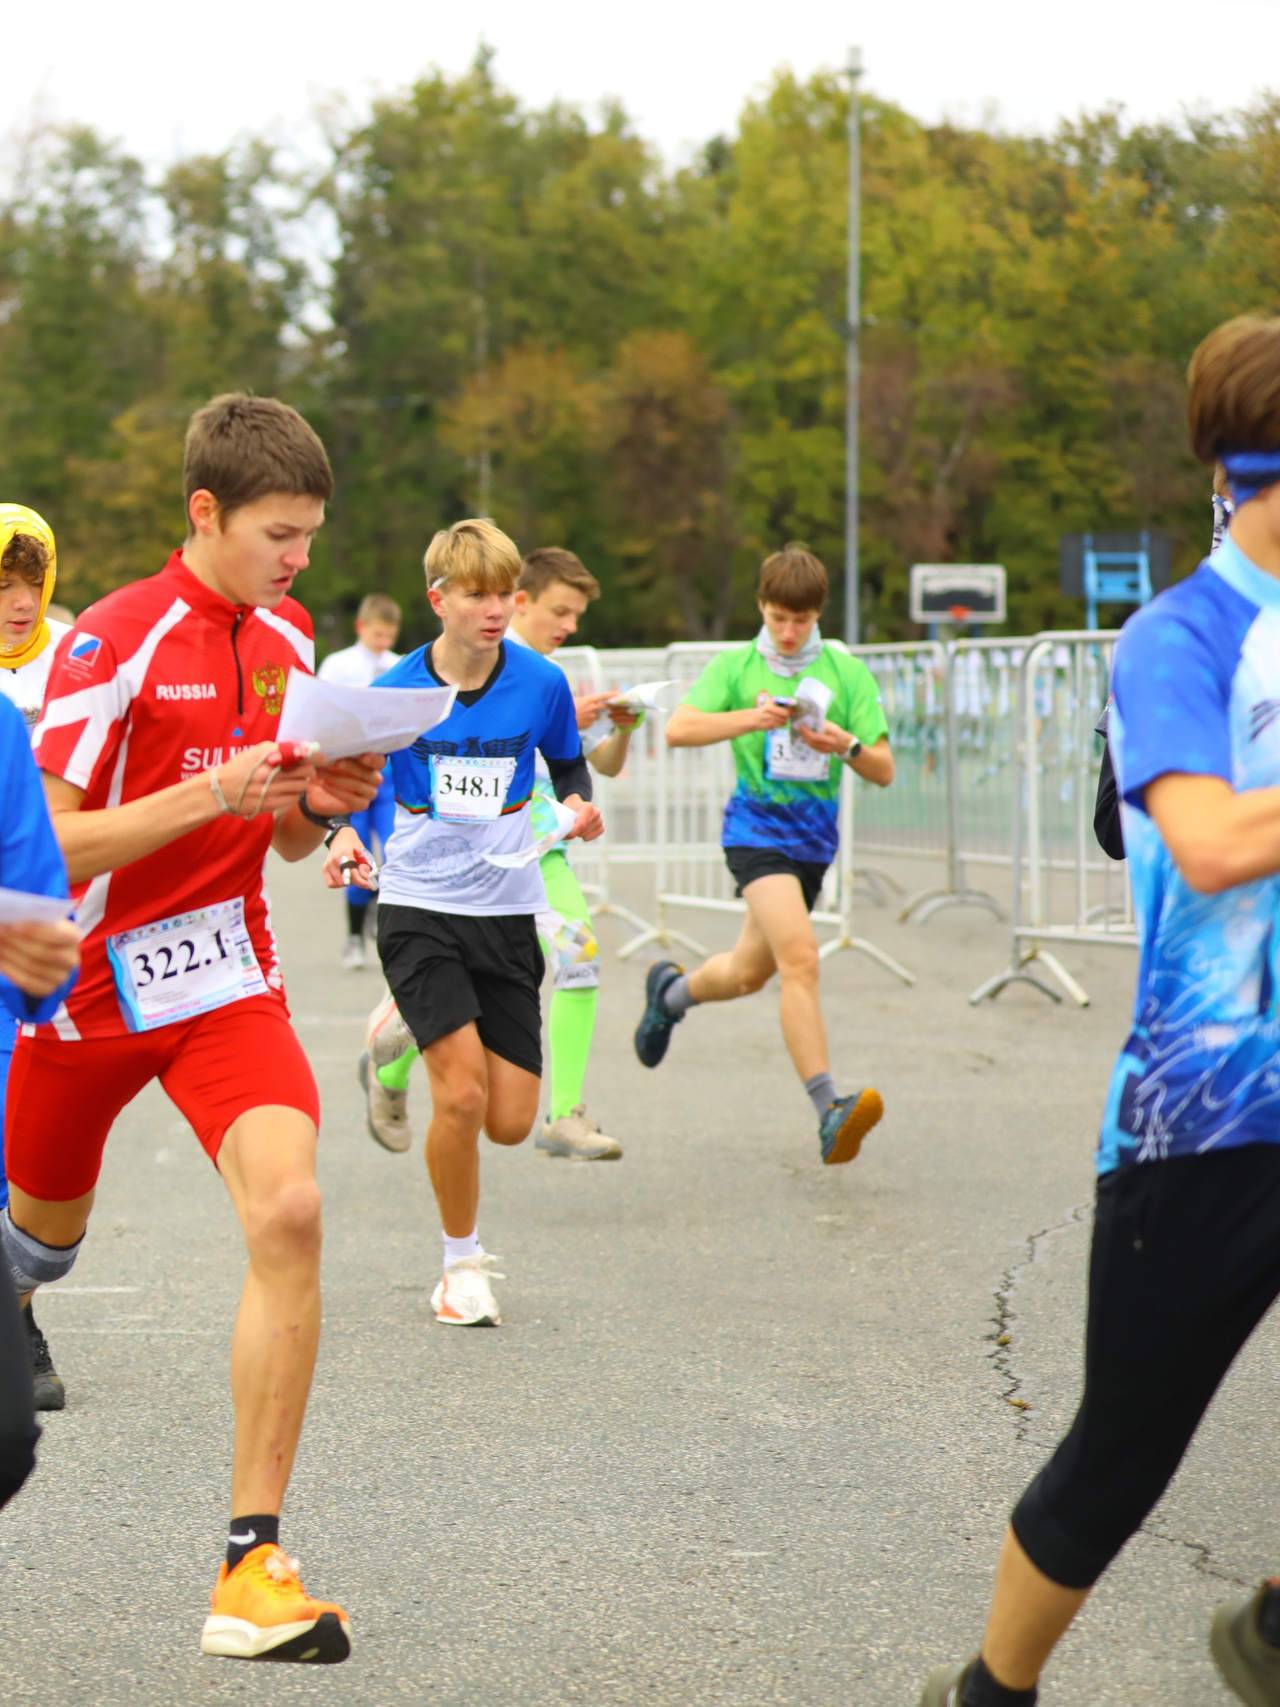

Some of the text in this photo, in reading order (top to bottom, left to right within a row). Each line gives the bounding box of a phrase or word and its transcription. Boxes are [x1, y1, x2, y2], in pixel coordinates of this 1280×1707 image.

[156, 683, 217, 700] RUSSIA
[439, 773, 500, 797] 348.1
[133, 928, 228, 987] 322.1
